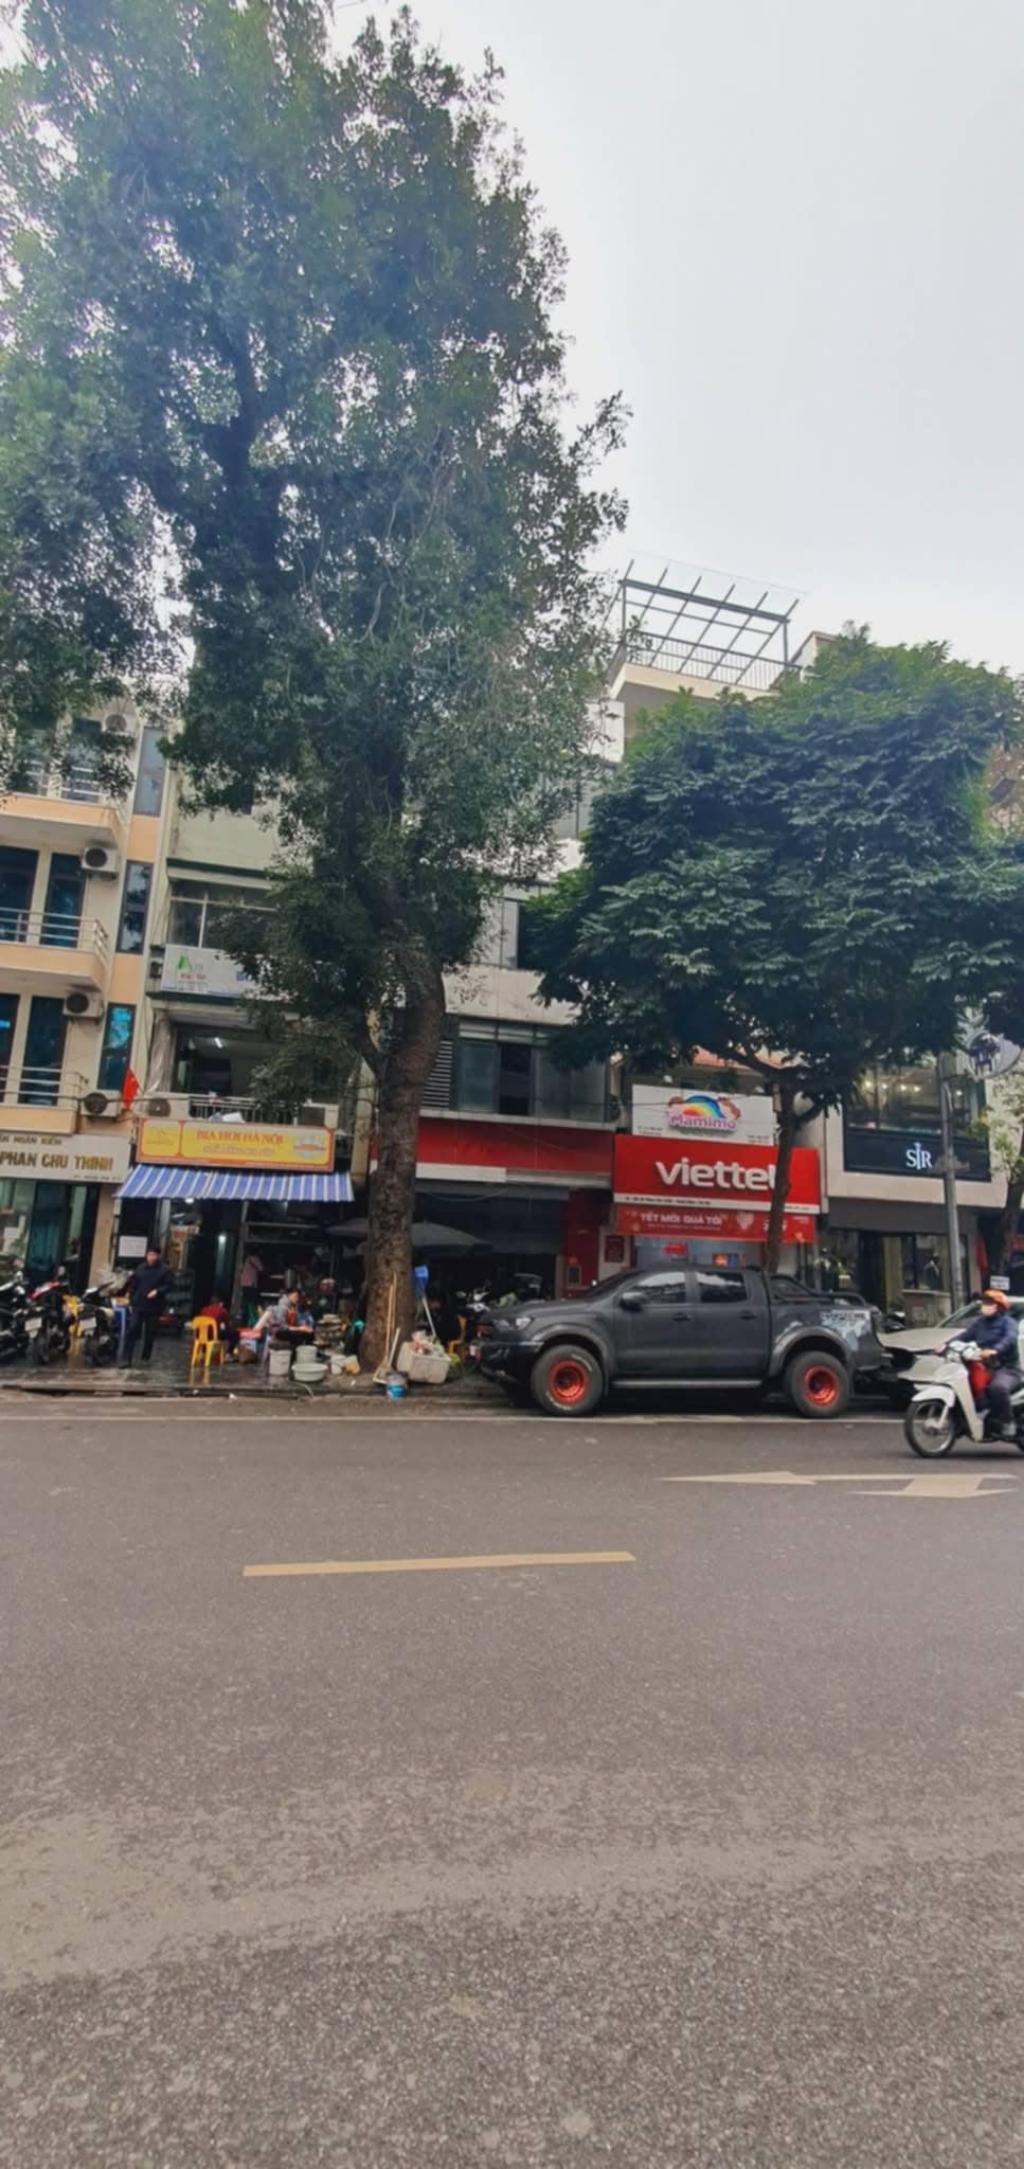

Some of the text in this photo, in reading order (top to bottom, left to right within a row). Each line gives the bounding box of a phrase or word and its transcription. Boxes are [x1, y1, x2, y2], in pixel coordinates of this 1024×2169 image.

[670, 1113, 737, 1130] Mamimo
[0, 1151, 37, 1167] PHAN
[41, 1153, 69, 1168] CHU
